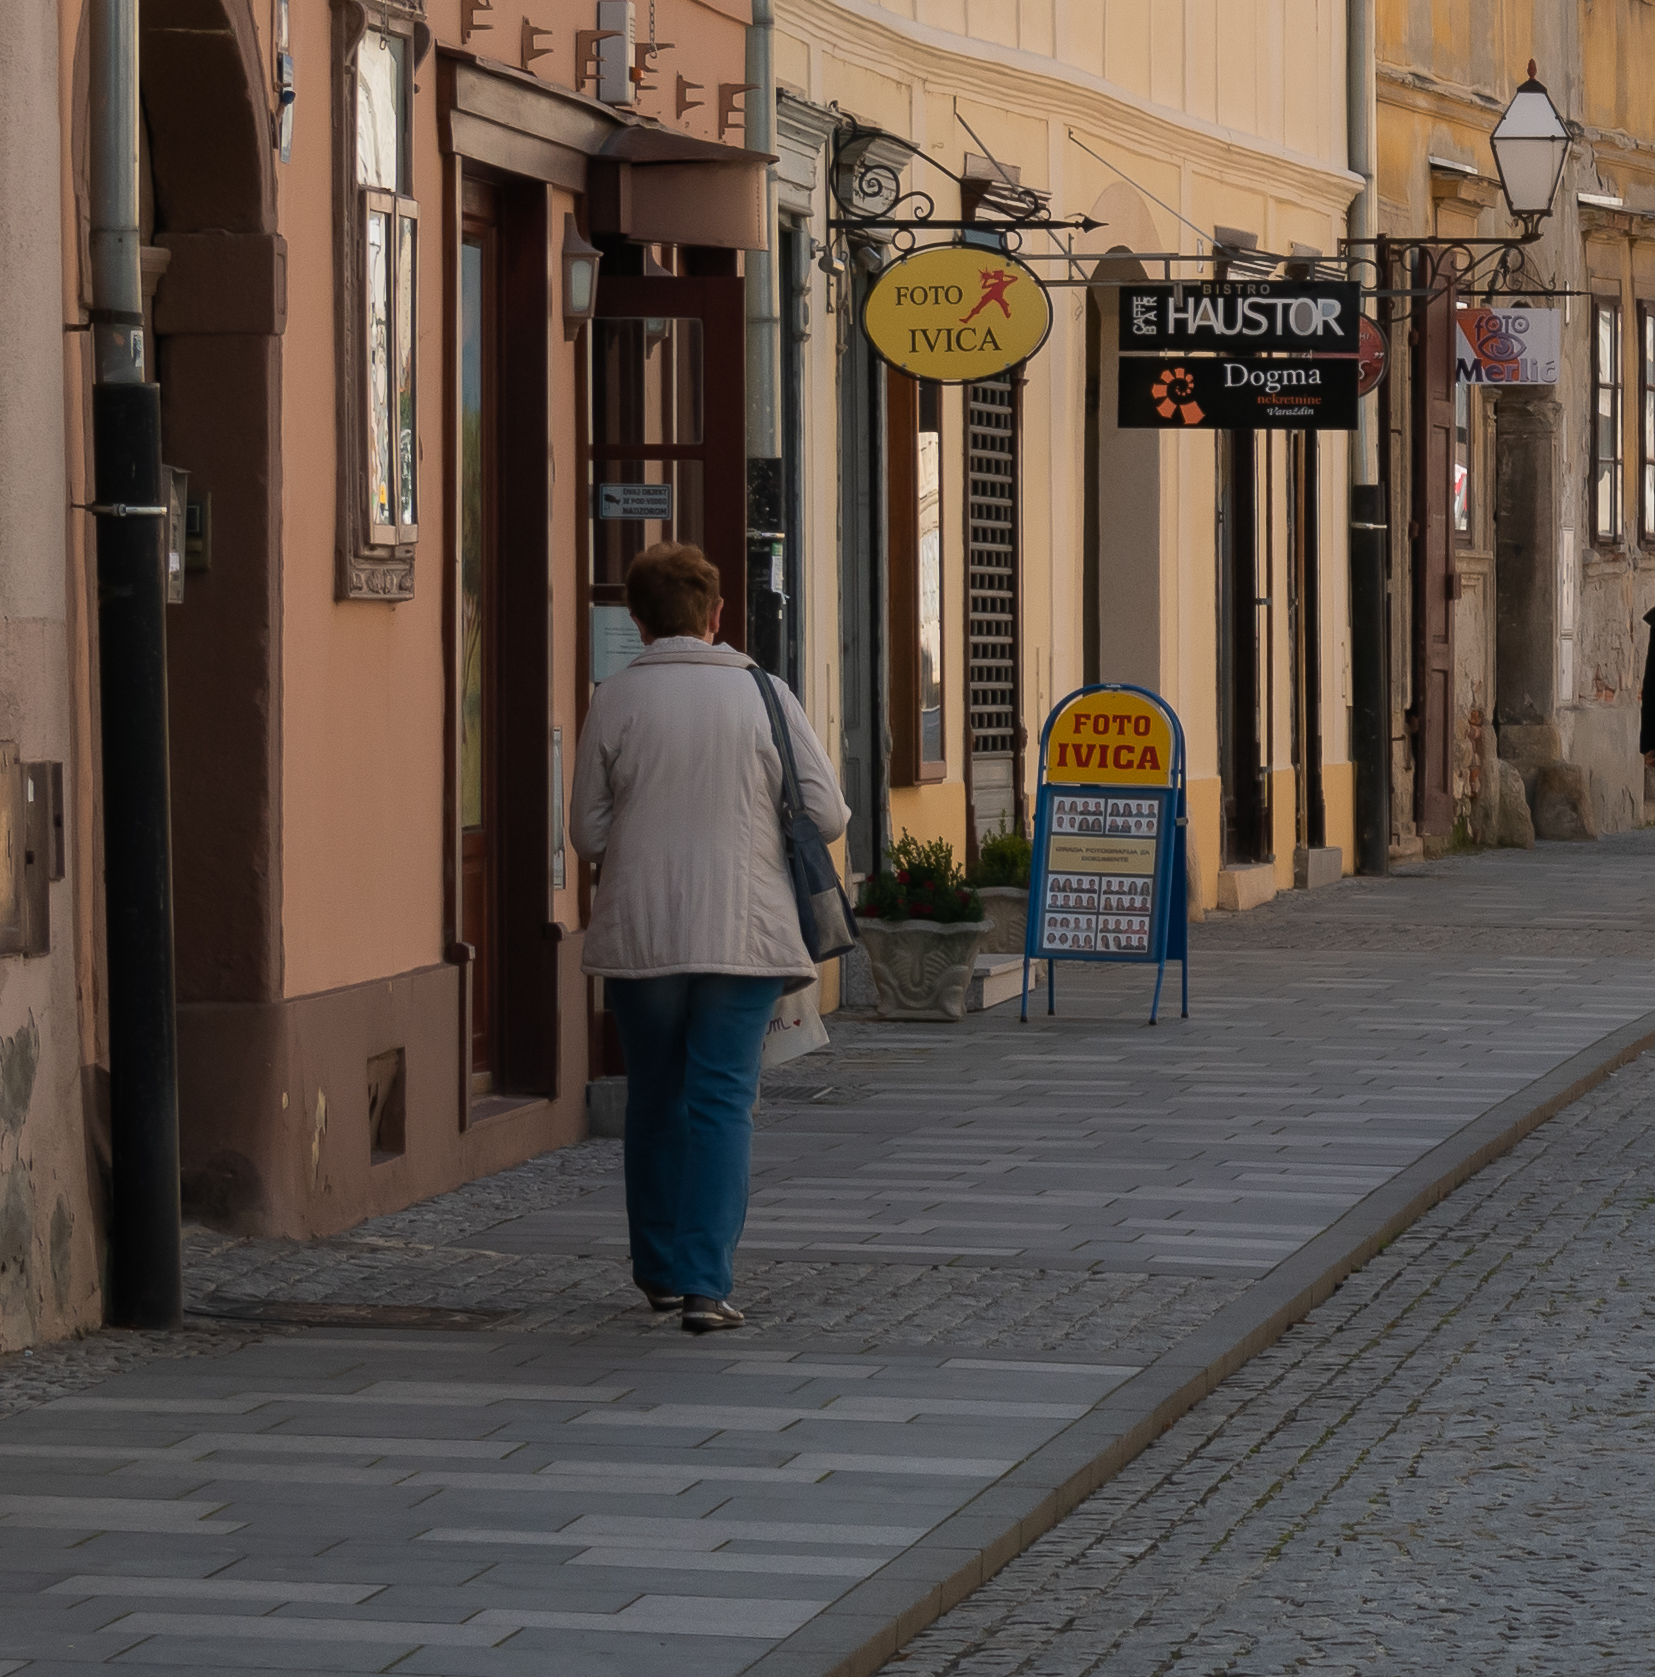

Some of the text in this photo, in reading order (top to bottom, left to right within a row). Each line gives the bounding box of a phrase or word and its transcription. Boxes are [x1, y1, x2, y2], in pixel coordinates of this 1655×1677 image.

[895, 285, 963, 306] FOTO
[1203, 284, 1271, 295] BISTRO
[1144, 296, 1158, 335] BAR
[1168, 297, 1345, 336] HAUSTOR
[909, 327, 1002, 353] IVICA
[1223, 363, 1322, 393] Dogma
[1457, 357, 1558, 384] Merlić
[1257, 393, 1322, 405] nekretnine
[1266, 406, 1315, 416] Varaždin
[1072, 713, 1151, 737] FOTO
[1056, 742, 1162, 771] IVICA
